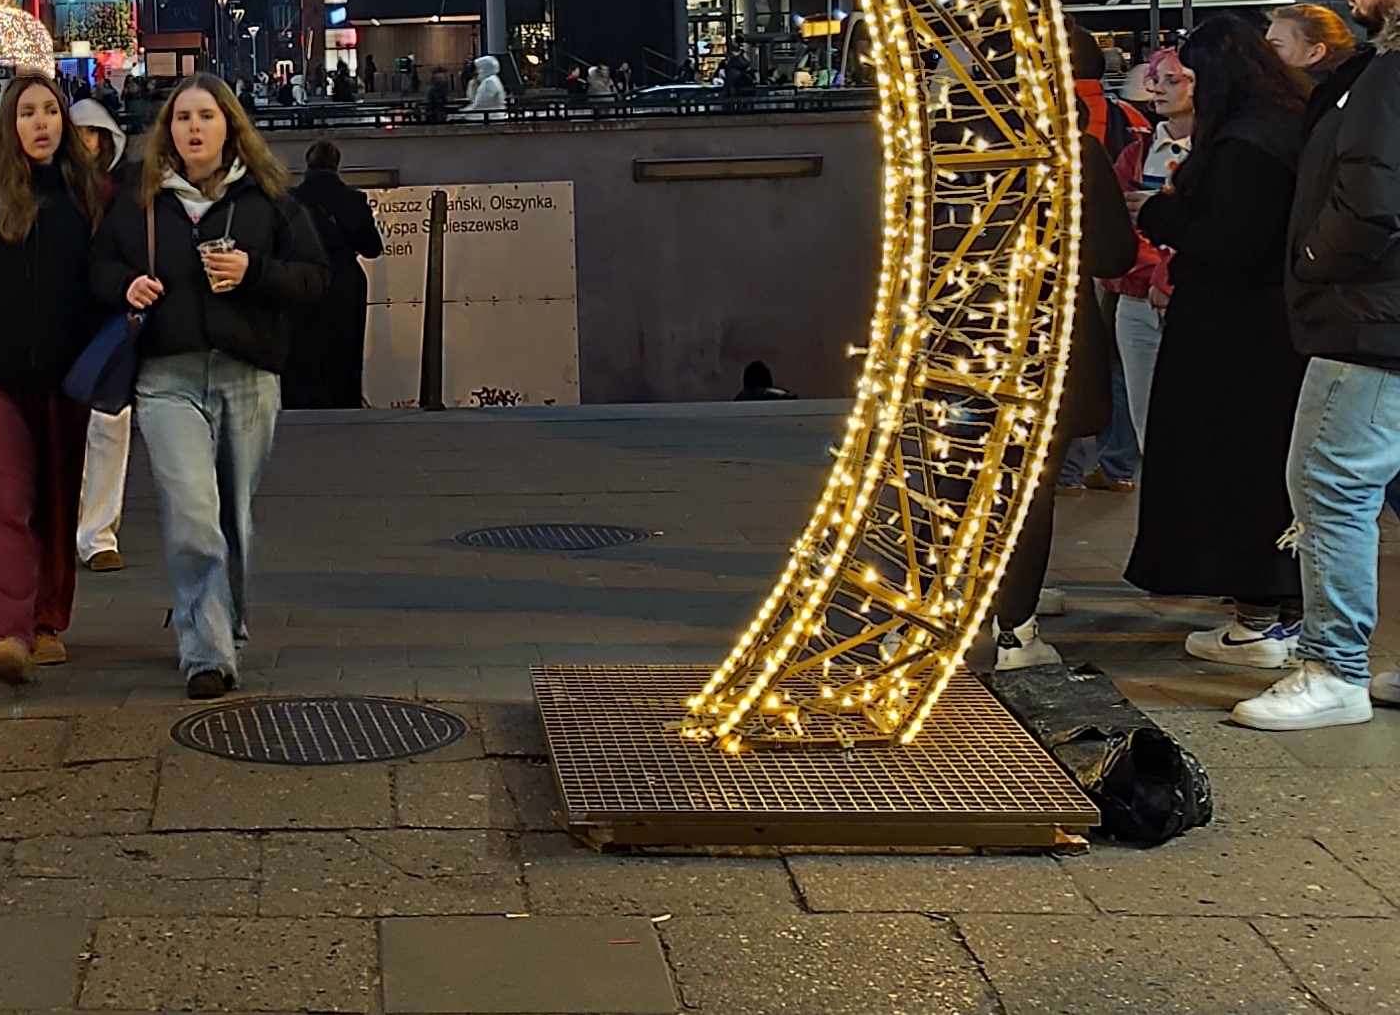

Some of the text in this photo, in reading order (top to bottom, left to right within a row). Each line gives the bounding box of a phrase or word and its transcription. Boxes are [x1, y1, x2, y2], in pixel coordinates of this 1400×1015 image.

[369, 194, 557, 213] Pruszcz ański, Olszynka,
[422, 217, 519, 235] Sieszewska
[382, 240, 413, 256] sień
